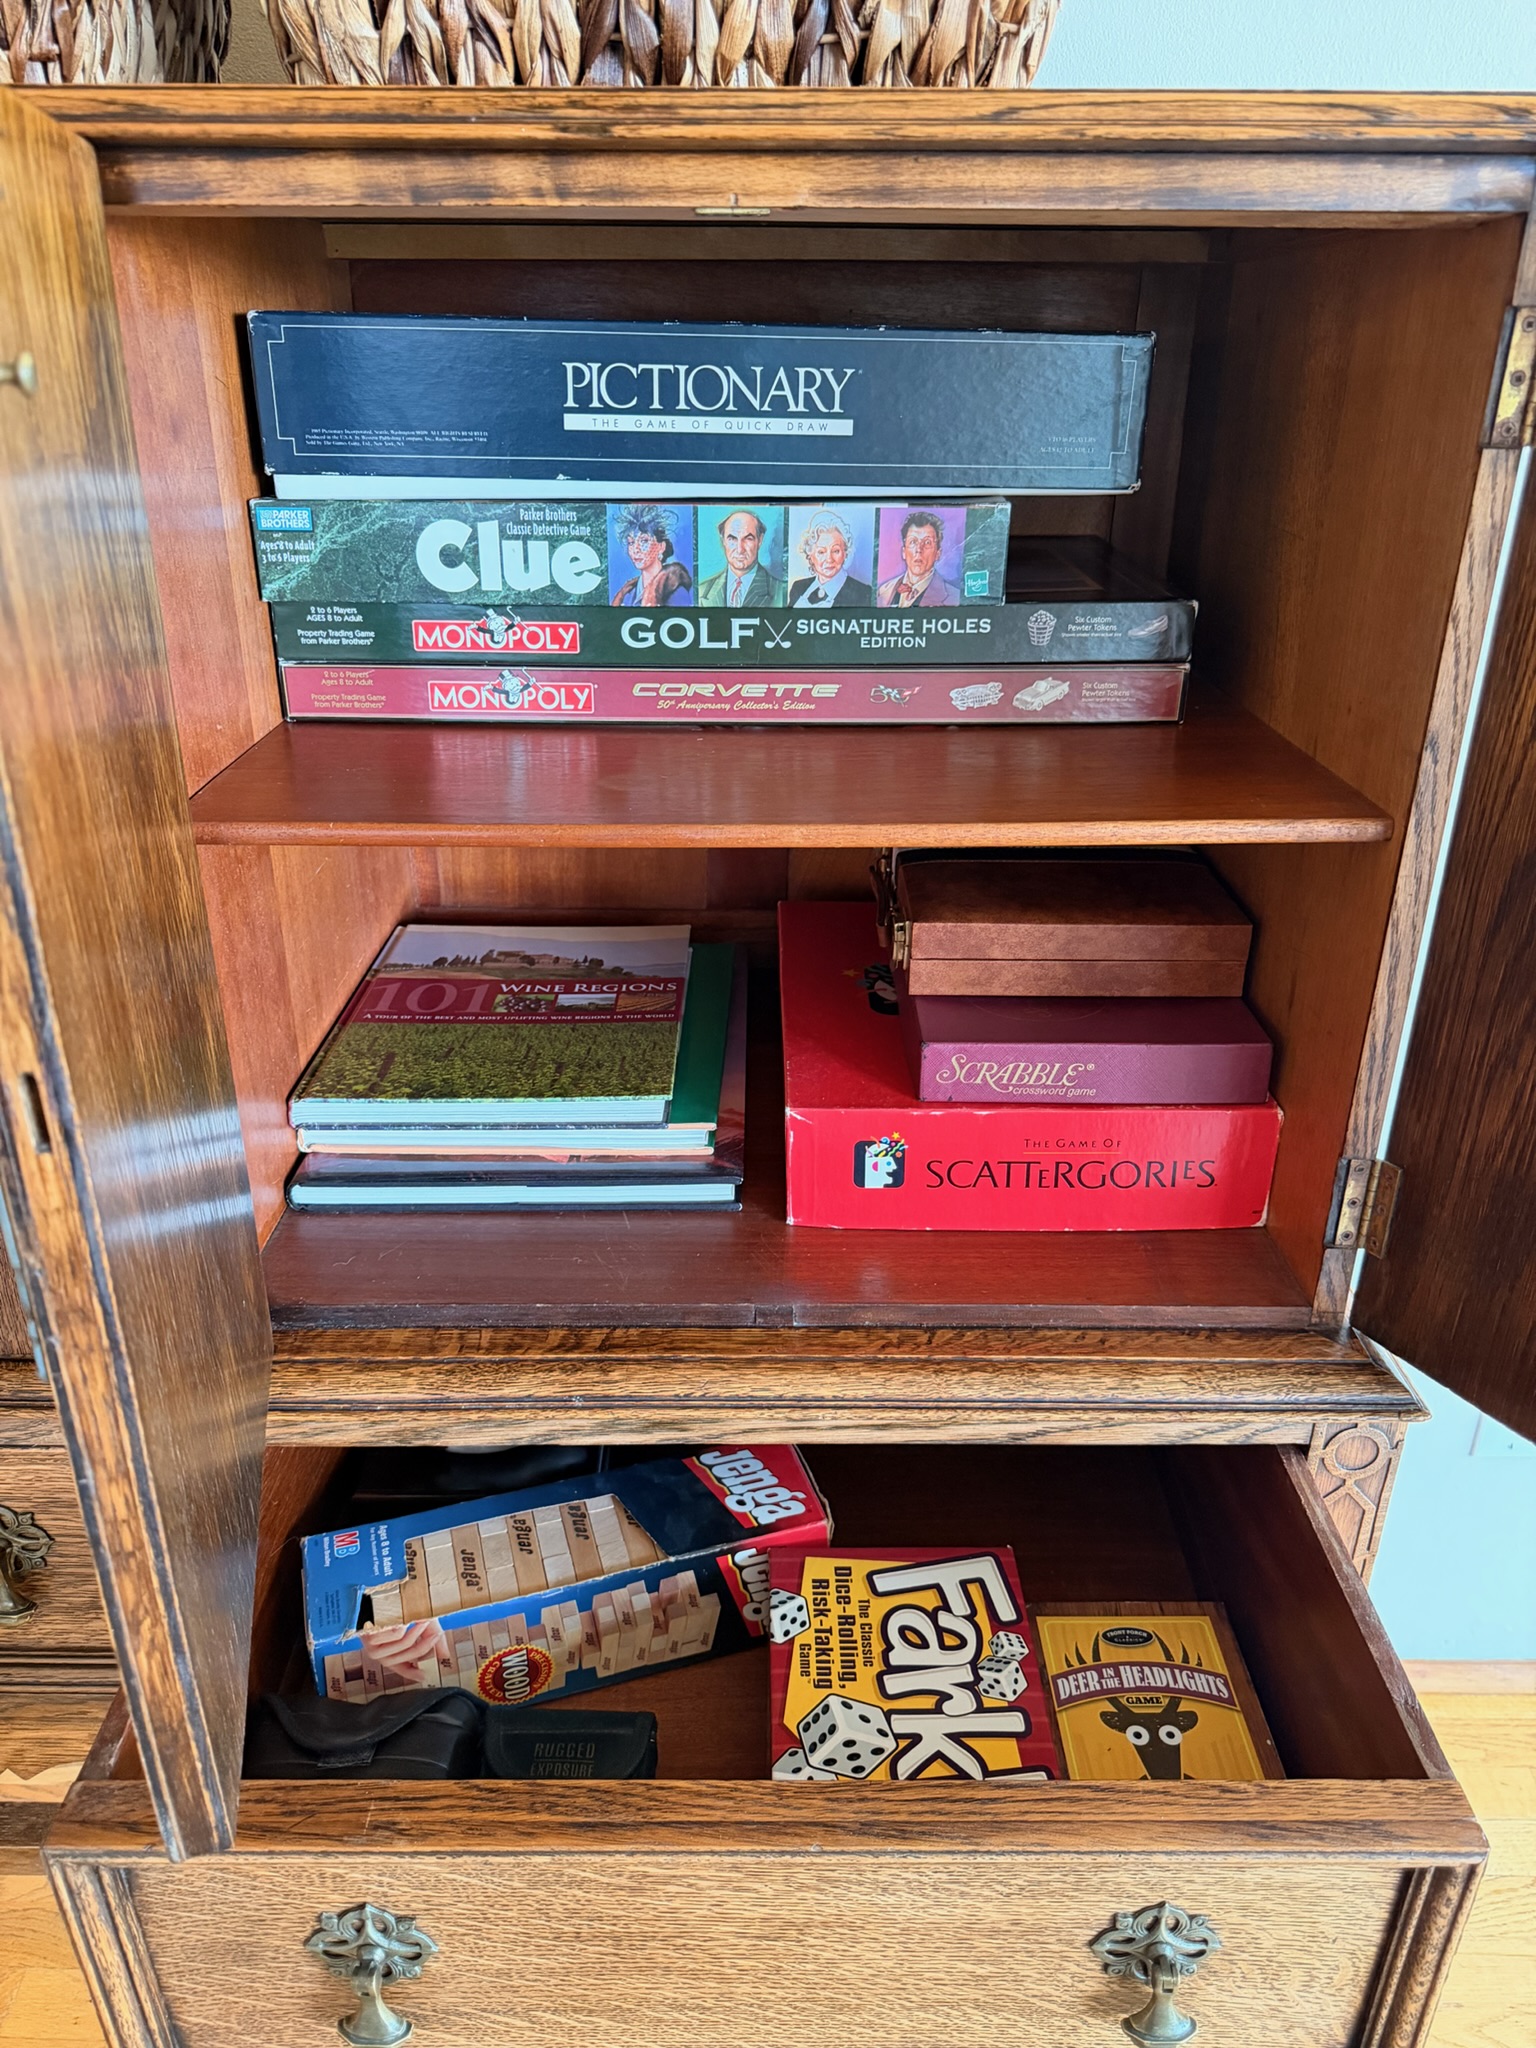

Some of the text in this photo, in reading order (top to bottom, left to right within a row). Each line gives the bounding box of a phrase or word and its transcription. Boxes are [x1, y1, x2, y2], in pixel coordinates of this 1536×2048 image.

[562, 361, 856, 413] PICTIONARY
[591, 418, 830, 432] THE GAME OF QUICK DRAW
[261, 519, 310, 528] BROTHERS
[272, 510, 308, 520] PARKER
[520, 508, 578, 522] Parker Brothers
[506, 523, 591, 536] Classic Detective Game
[260, 540, 315, 552] Ages 8 to Adult
[262, 554, 267, 564] 3
[283, 552, 310, 564] Players
[416, 518, 603, 594] Clue
[306, 614, 326, 622] AGES
[327, 614, 332, 622] 8
[343, 614, 364, 622] Adult
[310, 606, 316, 614] 2
[332, 606, 358, 615] Players
[296, 629, 376, 639] Property Trading Game
[620, 616, 760, 650] GOLF
[796, 618, 992, 634] SIGNATURE HOLES
[1094, 624, 1118, 632] Tokens
[418, 624, 575, 650] MONOPOLY
[860, 636, 926, 648] EDITION
[345, 671, 370, 679] Players
[310, 693, 340, 701] Property
[341, 693, 366, 702] Trading
[433, 685, 590, 710] MONOPOLY
[632, 682, 841, 698] CORVETTE
[676, 700, 731, 712] Anniversary
[732, 700, 780, 710] Collector's
[782, 700, 816, 711] Edition
[362, 981, 678, 1014] 101 WINE REGIONS
[936, 1054, 1085, 1093] SCRABBLE
[1012, 1086, 1097, 1098] crossword game
[926, 1160, 1216, 1190] SCATTERGORIES
[700, 1448, 807, 1526] Jenga
[566, 1503, 590, 1540] Jenga
[378, 1525, 388, 1540] Ages
[514, 1518, 534, 1555] Jenga
[333, 1530, 360, 1558] MB
[381, 1548, 390, 1556] to
[383, 1557, 393, 1576] Adult
[460, 1548, 481, 1588] Jenga
[812, 1578, 834, 1689] Risk-Taking
[834, 1566, 858, 1689] Dice-Rolling,
[858, 1598, 876, 1668] The Classic
[528, 1650, 550, 1689] PRECISION
[799, 1644, 812, 1678] Game
[870, 1554, 1050, 1780] Fark
[484, 1660, 504, 1699] CRAFTED
[500, 1648, 532, 1700] WOOD
[1056, 1664, 1230, 1700] DEER IN THE HEADLIGHTS
[1126, 1696, 1164, 1705] GAME
[534, 1742, 596, 1759] RUGGED
[529, 1762, 595, 1778] EXPOSURE
